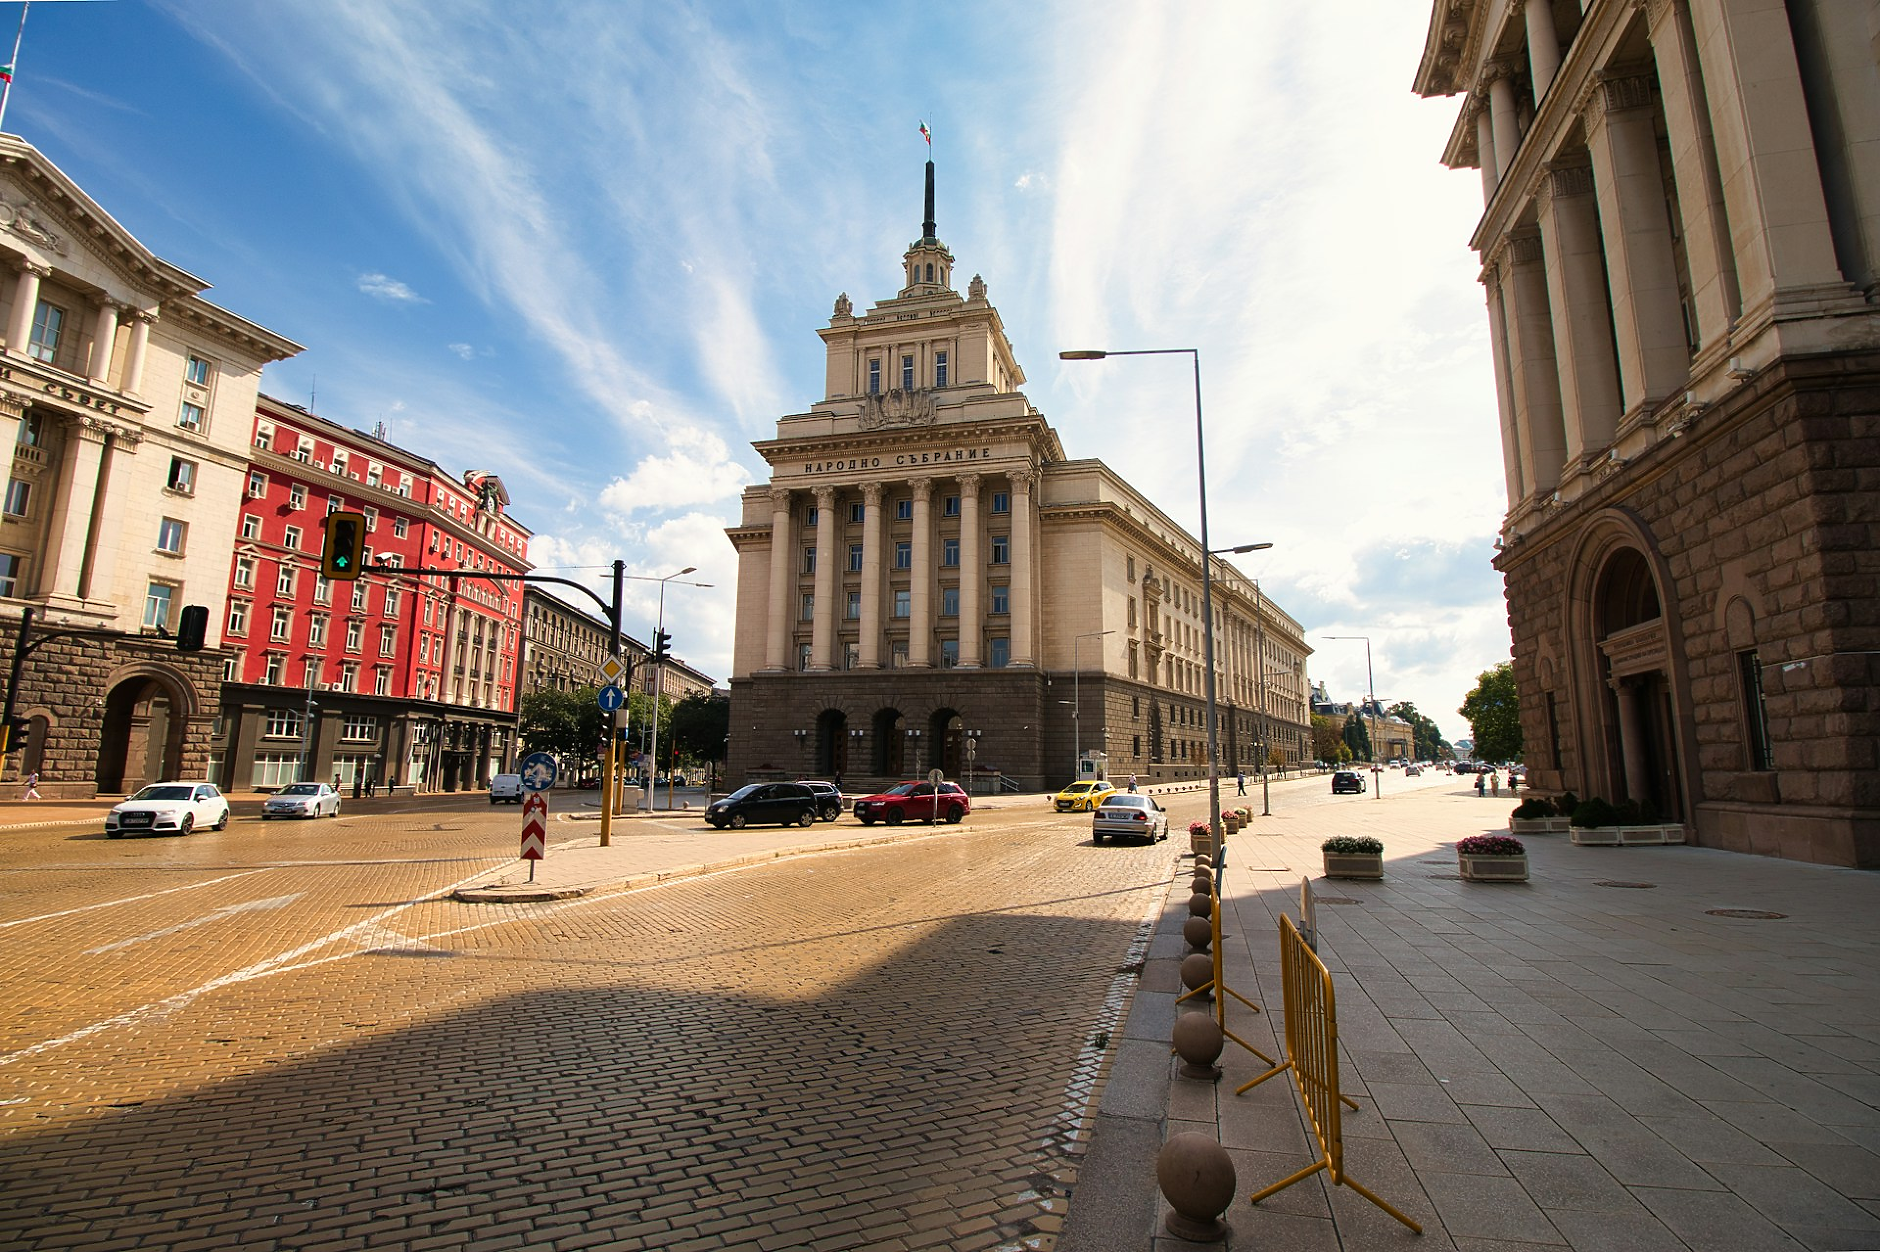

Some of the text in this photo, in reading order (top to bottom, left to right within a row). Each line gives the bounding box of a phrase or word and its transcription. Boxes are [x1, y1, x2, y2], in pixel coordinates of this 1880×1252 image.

[43, 382, 120, 414] СЪВЕТ
[805, 447, 990, 473] НАРОДНО СЪБРАНИЕ
